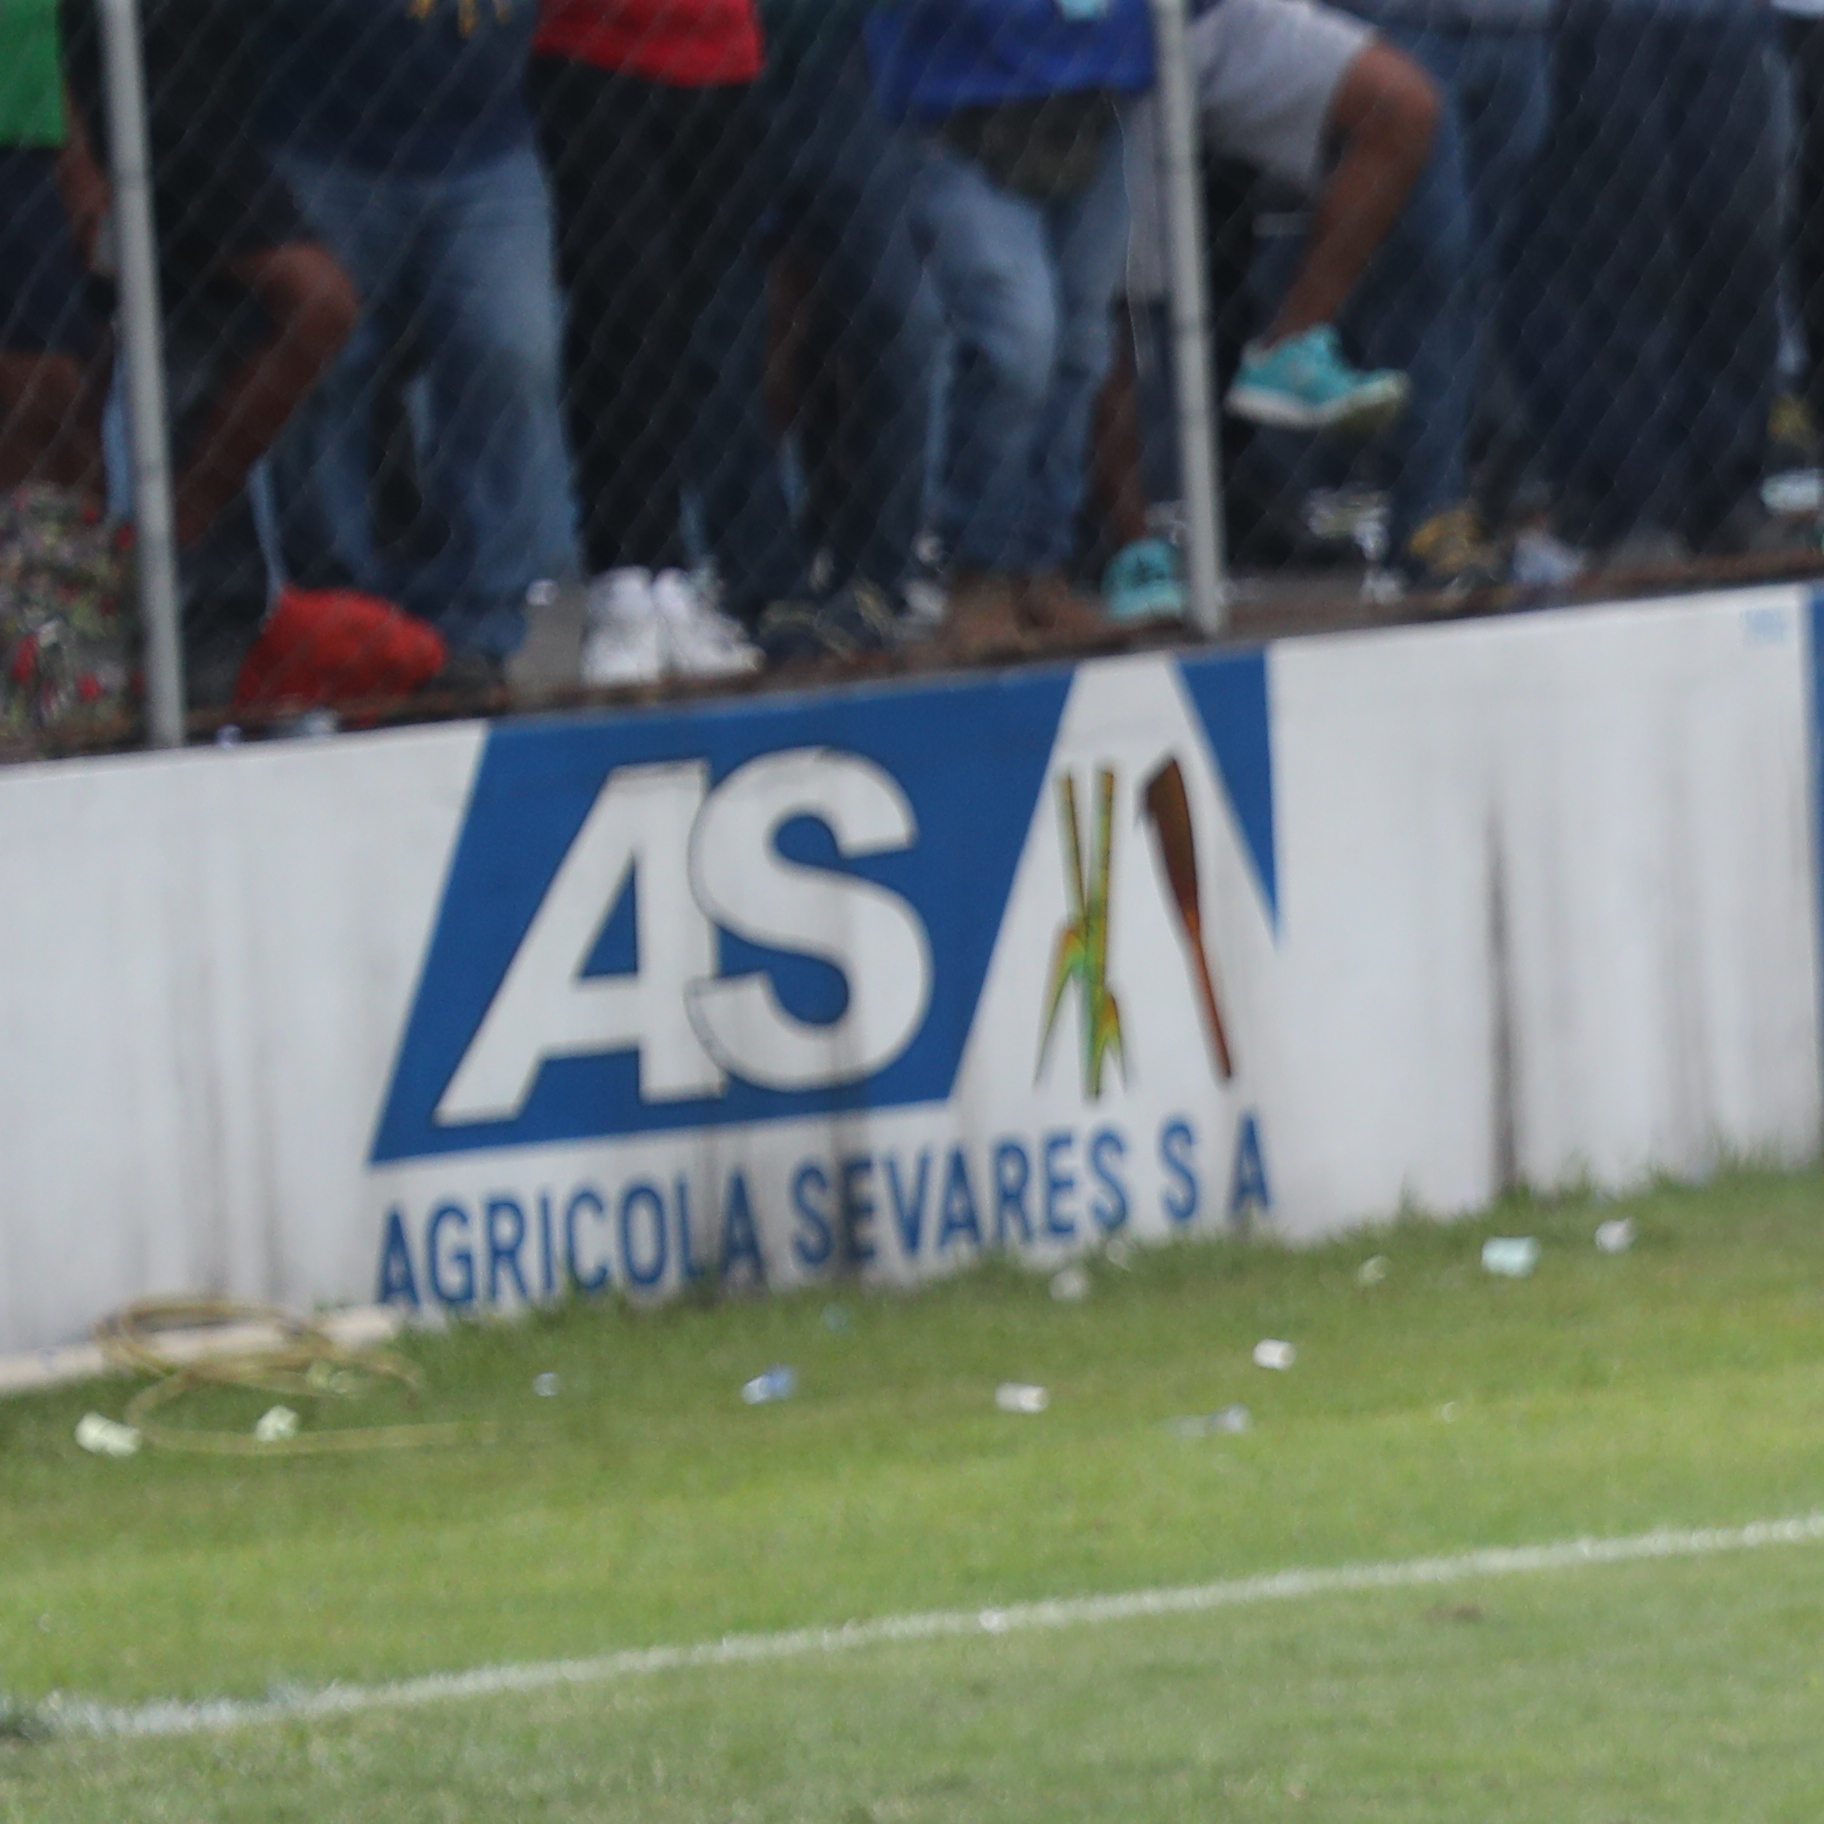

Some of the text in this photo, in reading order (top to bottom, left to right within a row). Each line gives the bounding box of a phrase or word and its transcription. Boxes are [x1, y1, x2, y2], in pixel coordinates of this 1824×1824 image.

[377, 1110, 1271, 1307] AGRICOLA SEVARES S A
